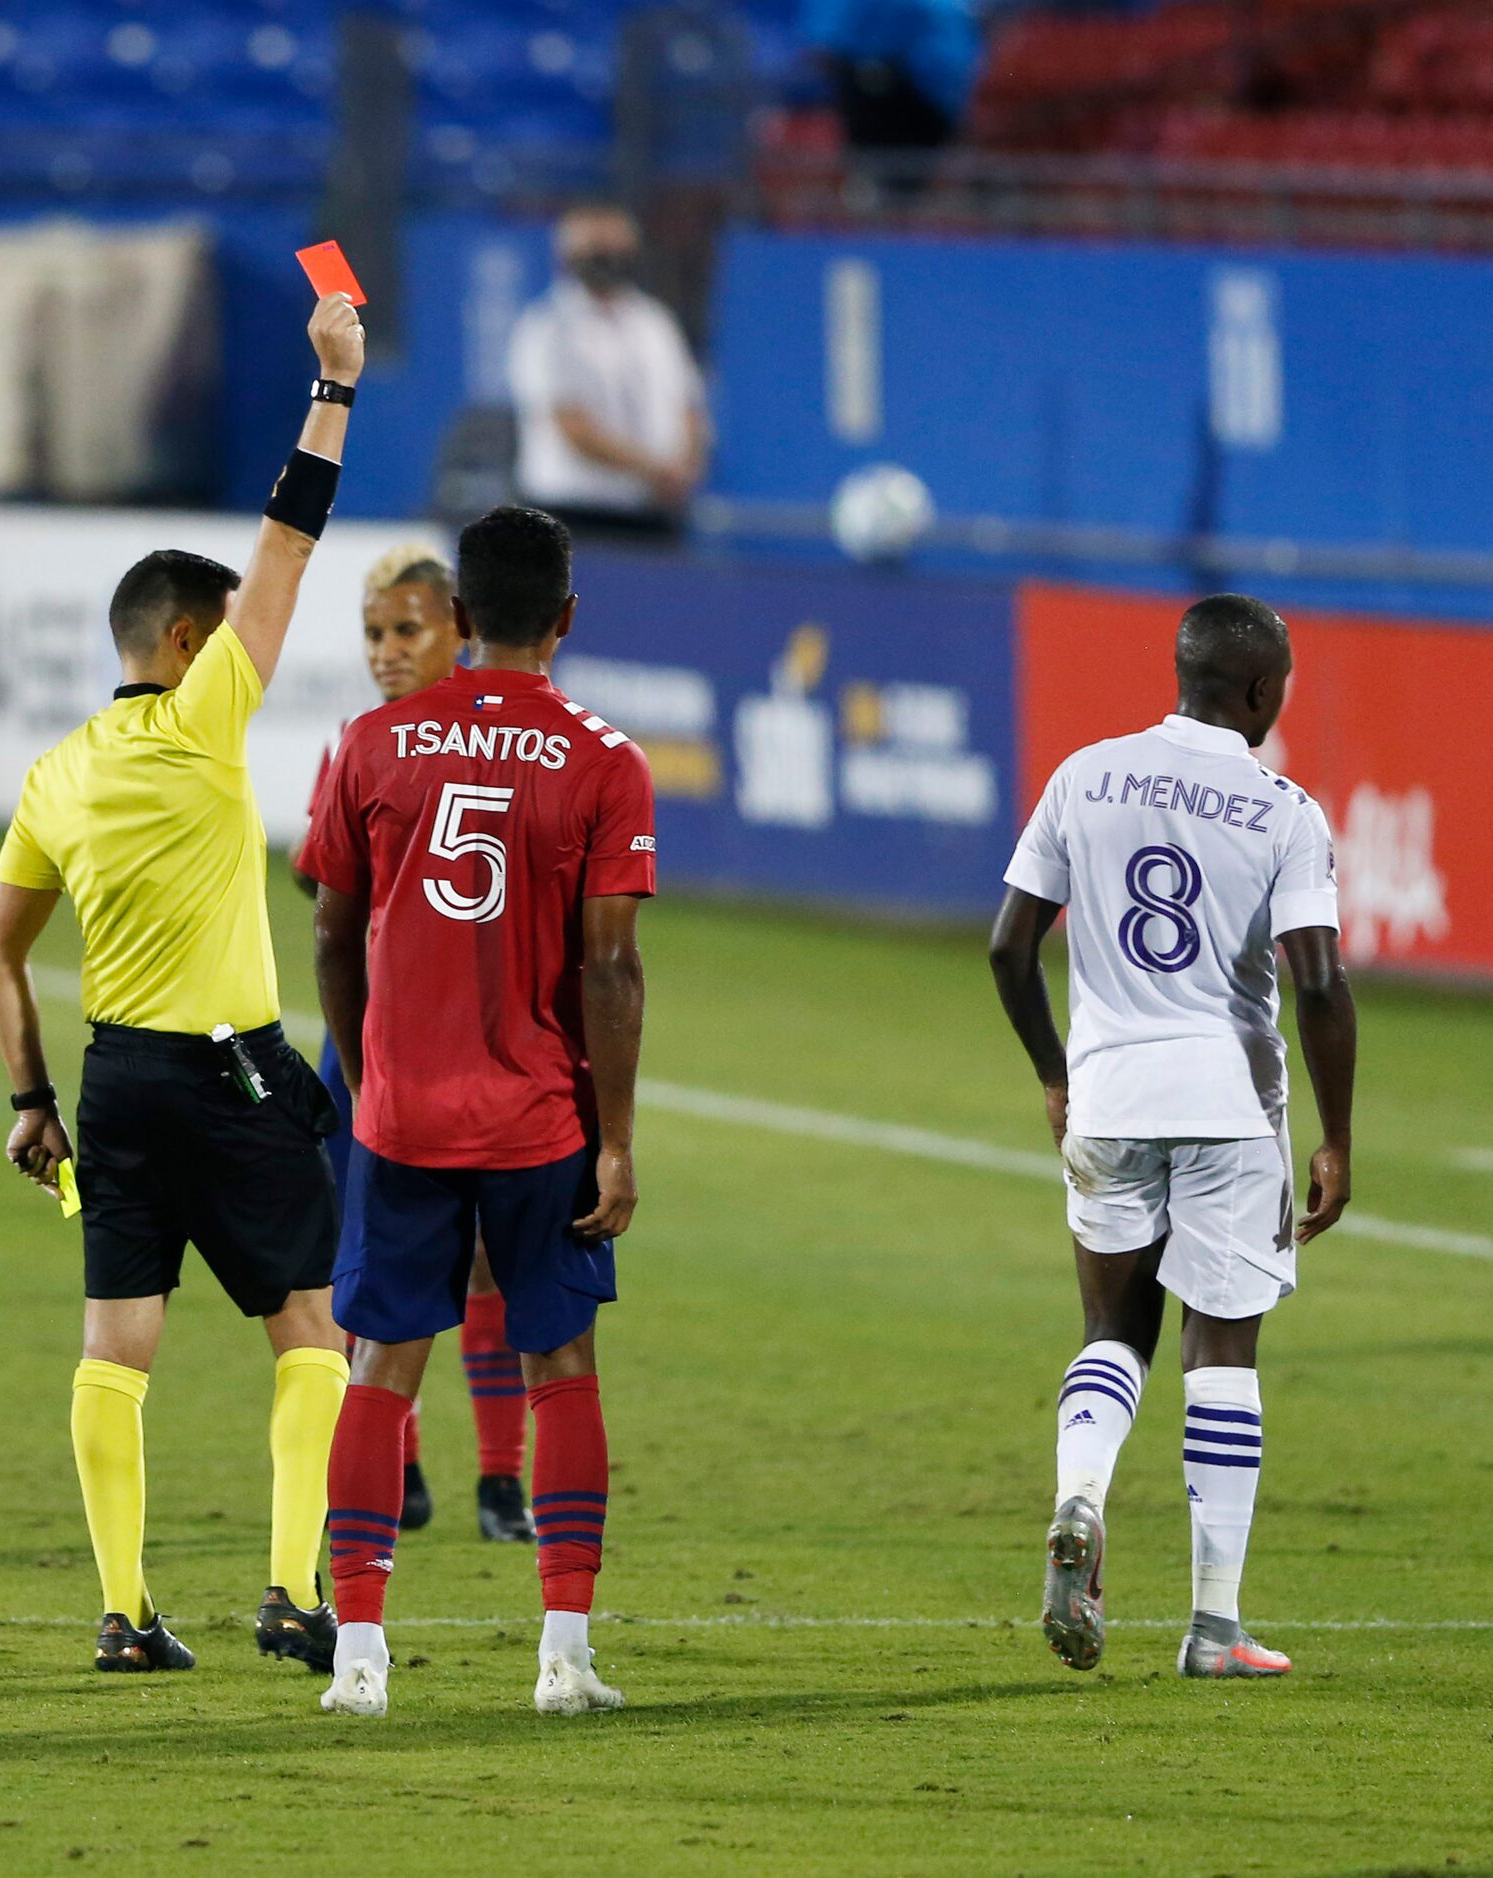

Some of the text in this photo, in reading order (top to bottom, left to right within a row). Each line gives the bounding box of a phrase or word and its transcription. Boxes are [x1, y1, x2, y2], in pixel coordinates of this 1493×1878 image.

[422, 782, 515, 924] 5
[1085, 771, 1275, 834] J. MENDEZ
[1118, 842, 1203, 974] 8
